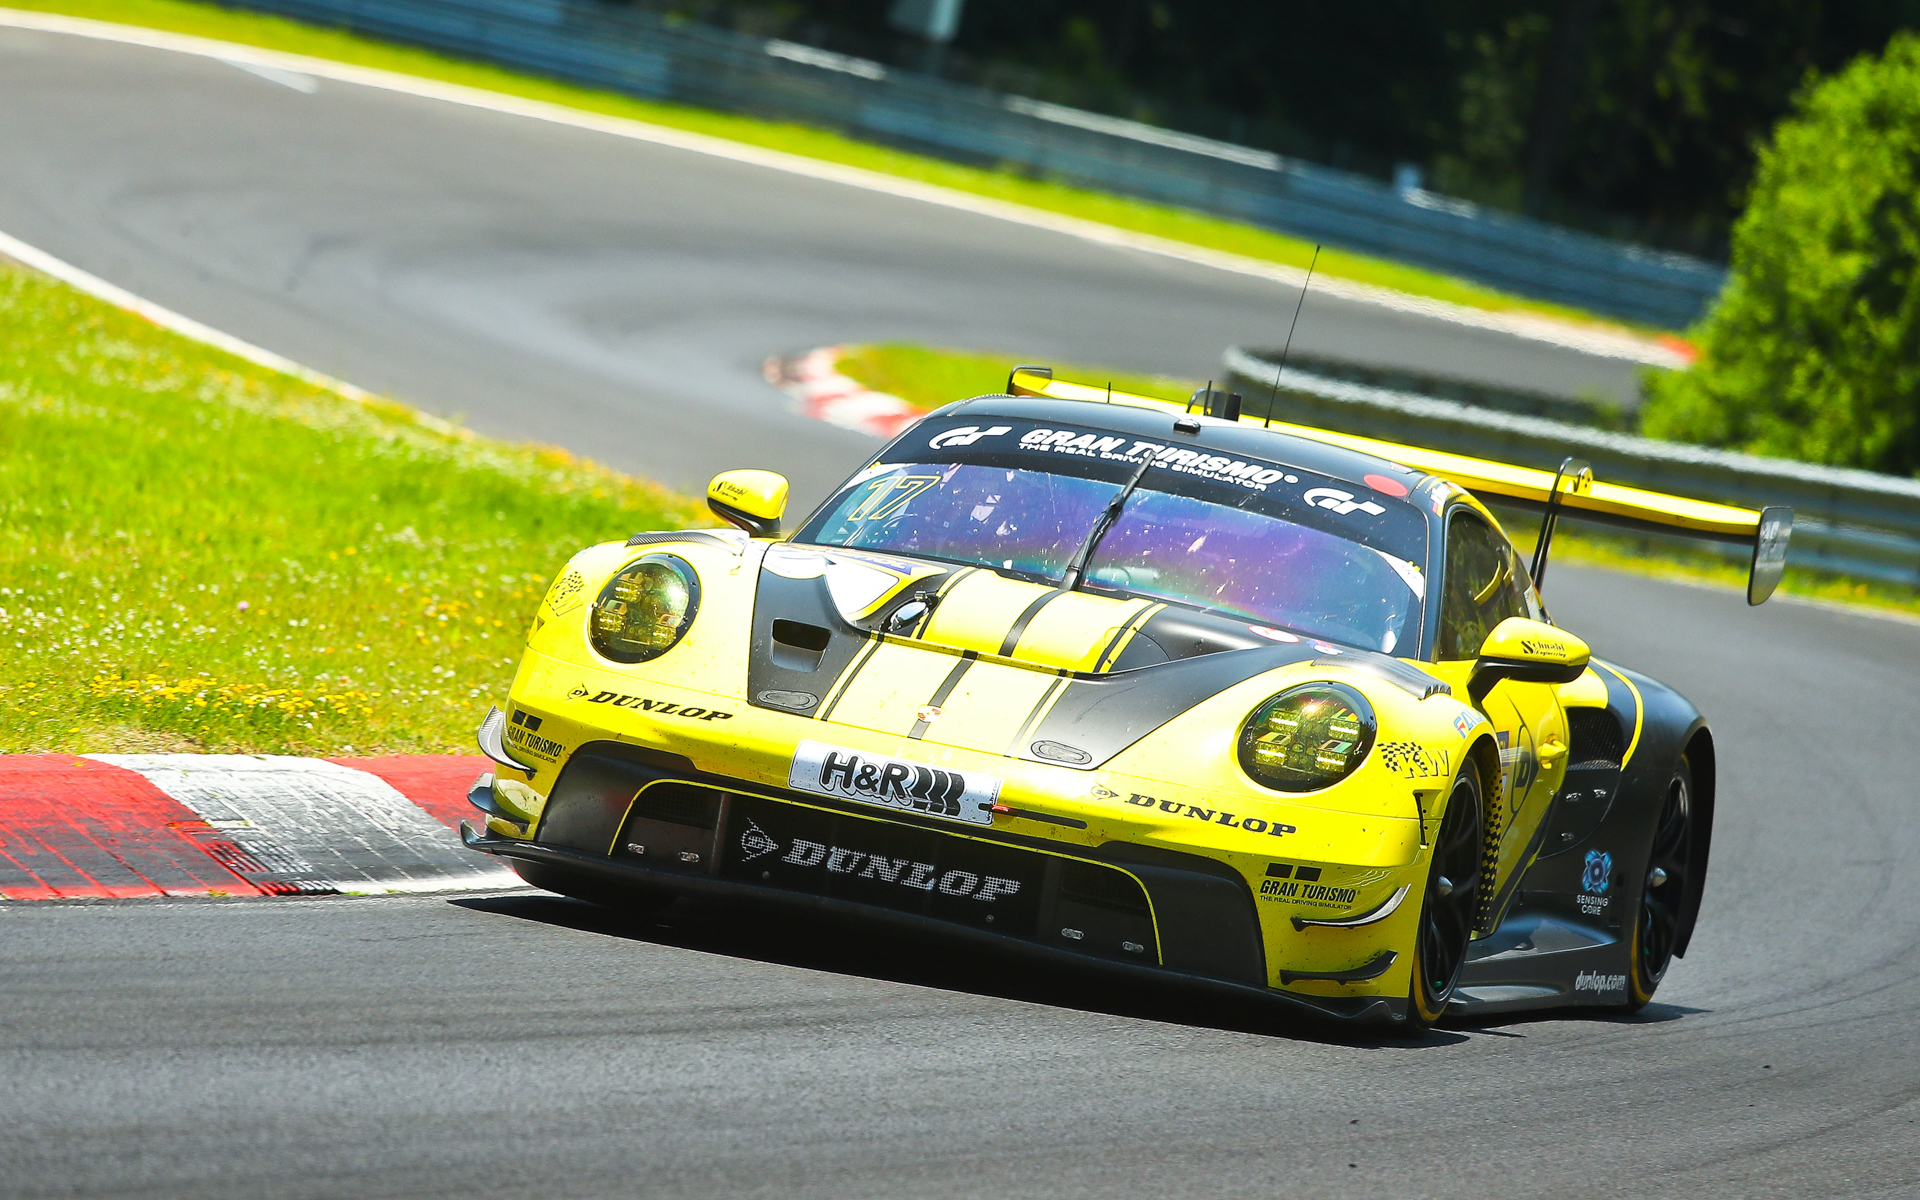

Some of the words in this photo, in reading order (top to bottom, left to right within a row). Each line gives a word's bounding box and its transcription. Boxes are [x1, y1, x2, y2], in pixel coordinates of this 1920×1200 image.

[1019, 442, 1051, 452] THE
[1053, 446, 1096, 457] REAL
[1171, 463, 1267, 492] SIMULATOR
[1020, 428, 1126, 452] GRAN
[1125, 440, 1284, 484] TURISMO
[846, 475, 942, 521] 17
[587, 691, 734, 721] DUNLOP
[525, 733, 563, 757] TURISMO
[820, 751, 911, 800] H&R
[1397, 749, 1451, 779] KW
[1125, 793, 1297, 837] DUNLOP
[782, 838, 1021, 902] DUNLOP
[1260, 880, 1300, 897] GRAN
[1301, 884, 1357, 904] TURISMO
[1292, 899, 1318, 907] DRIVING
[1318, 902, 1352, 911] SIMULATOR
[1576, 894, 1609, 907] SENSING
[1581, 905, 1602, 916] CORE
[1575, 970, 1626, 995] dunlop.com
